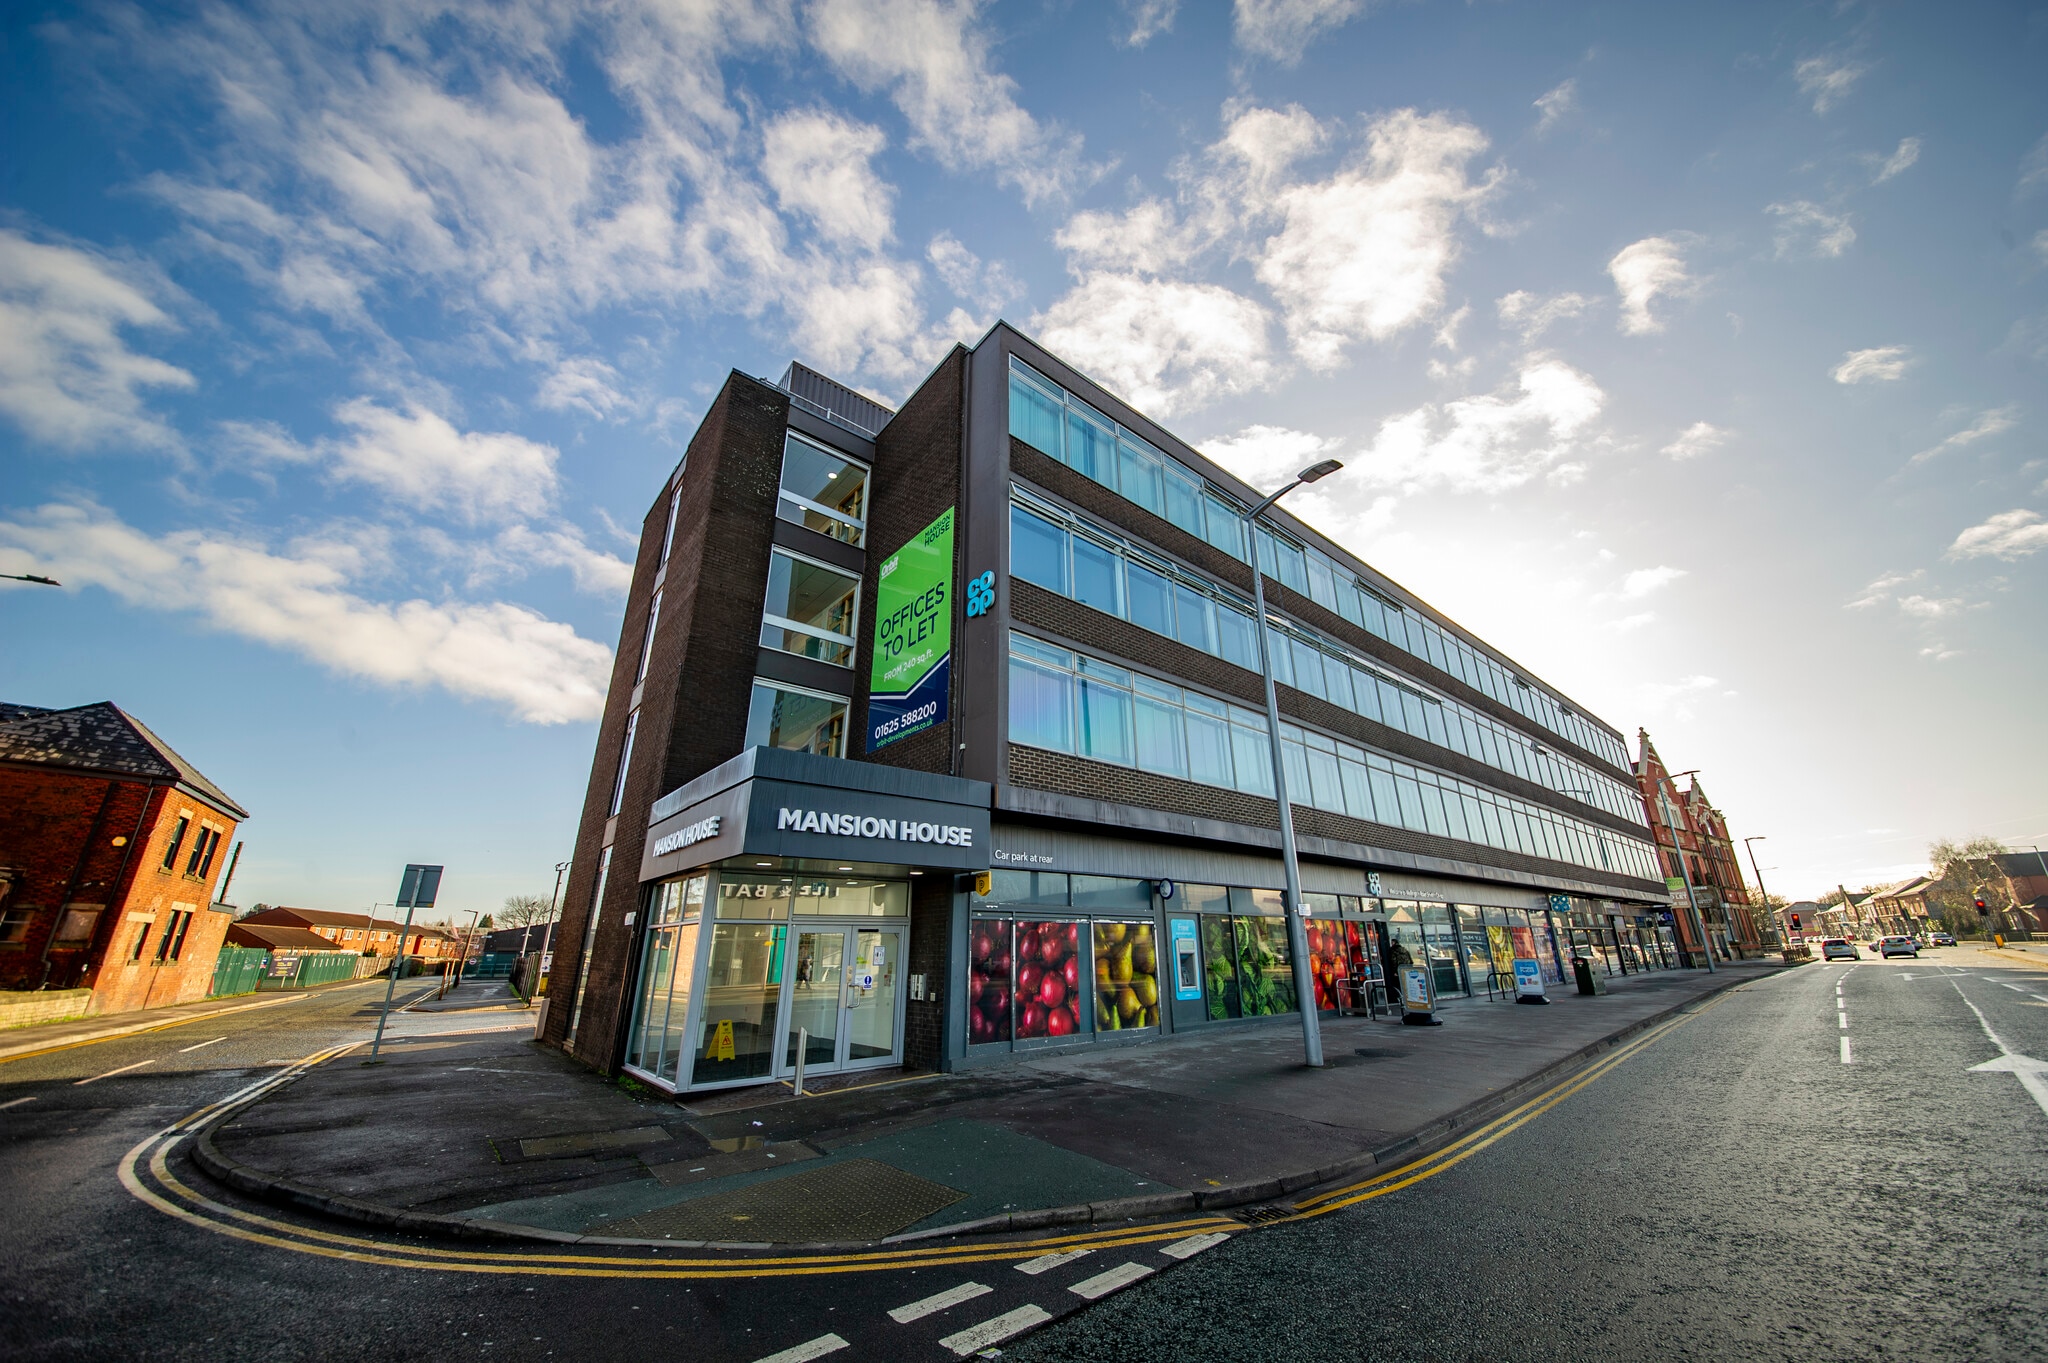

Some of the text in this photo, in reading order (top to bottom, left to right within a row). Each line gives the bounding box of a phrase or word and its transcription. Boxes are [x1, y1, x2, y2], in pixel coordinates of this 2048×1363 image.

[925, 513, 951, 538] MANSION
[925, 520, 951, 547] HOUSE
[880, 581, 945, 639] OFFICES
[883, 611, 939, 661] TO LET
[883, 664, 902, 682] FROM
[902, 657, 916, 672] 240
[874, 700, 937, 739] 01625 588200
[876, 718, 934, 748] orbit-developments.co.uk
[653, 815, 720, 857] MANSION HOUSE
[777, 808, 972, 848] MANSION HOUSE
[994, 849, 1053, 864] Car park at rear
